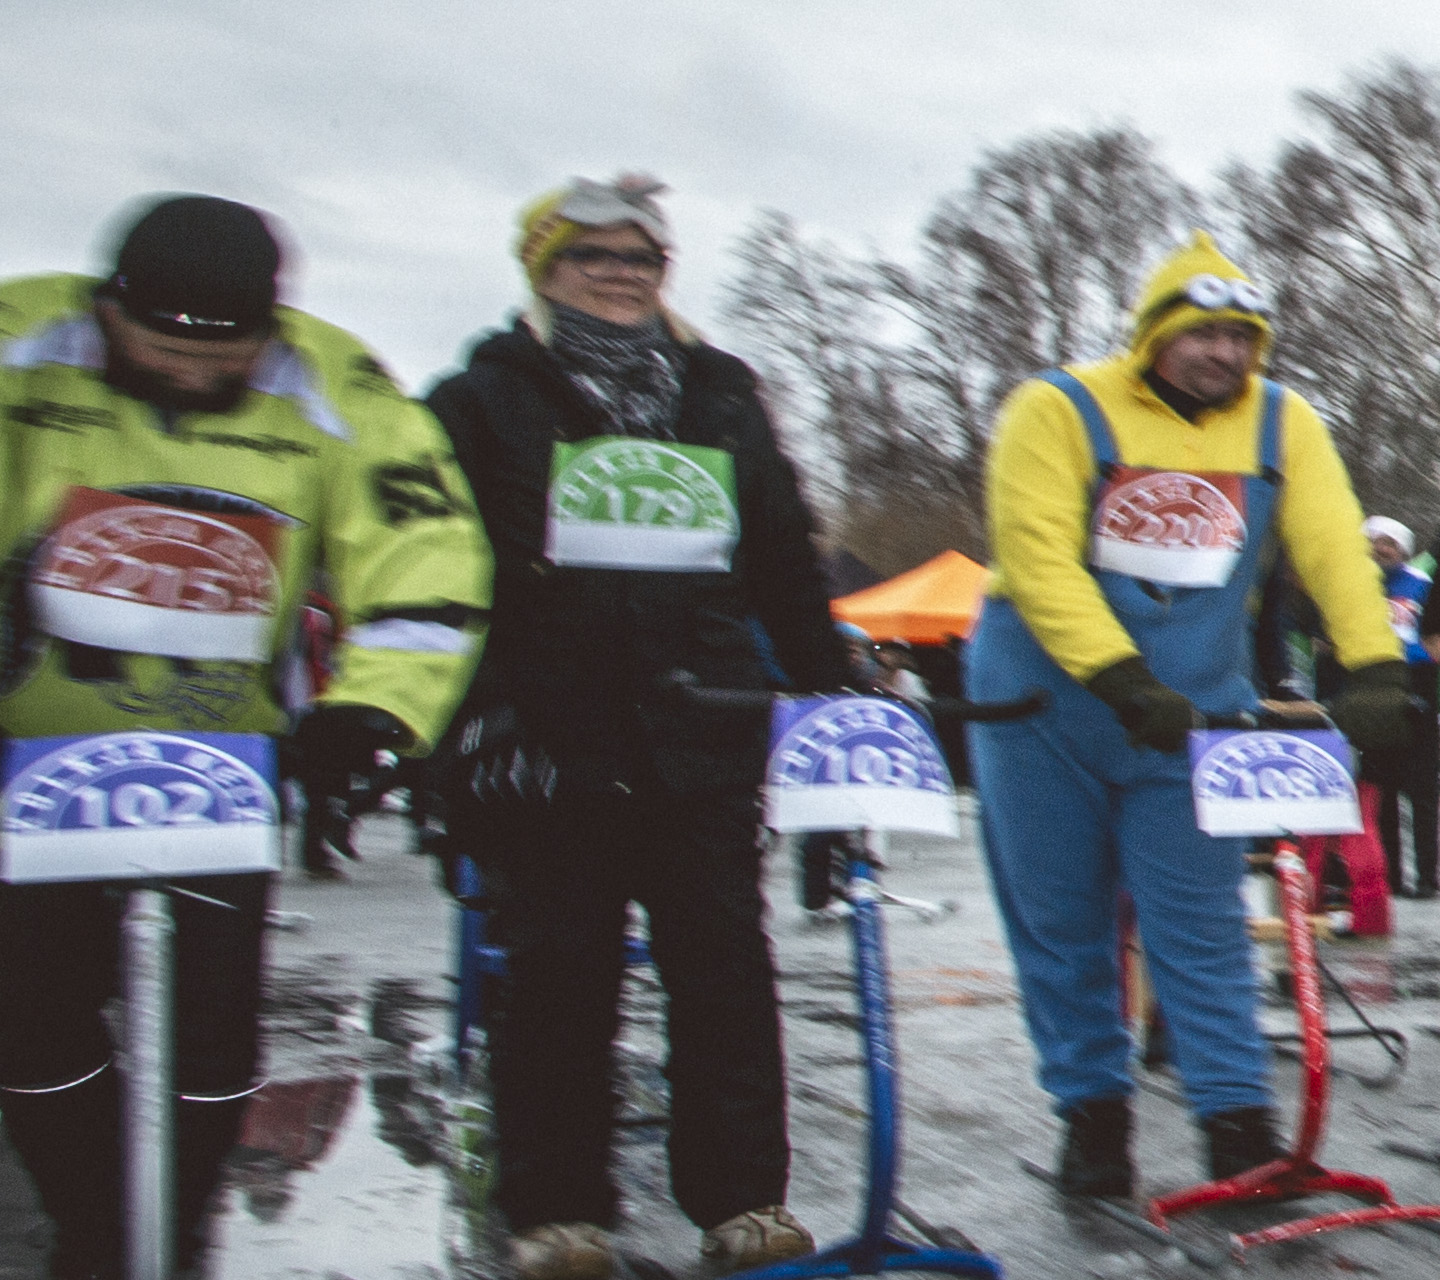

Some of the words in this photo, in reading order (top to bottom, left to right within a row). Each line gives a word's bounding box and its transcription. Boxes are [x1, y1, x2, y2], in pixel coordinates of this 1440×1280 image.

[601, 485, 698, 526] 179
[90, 551, 236, 612] 215
[821, 743, 922, 788] 103
[71, 780, 216, 827] 102
